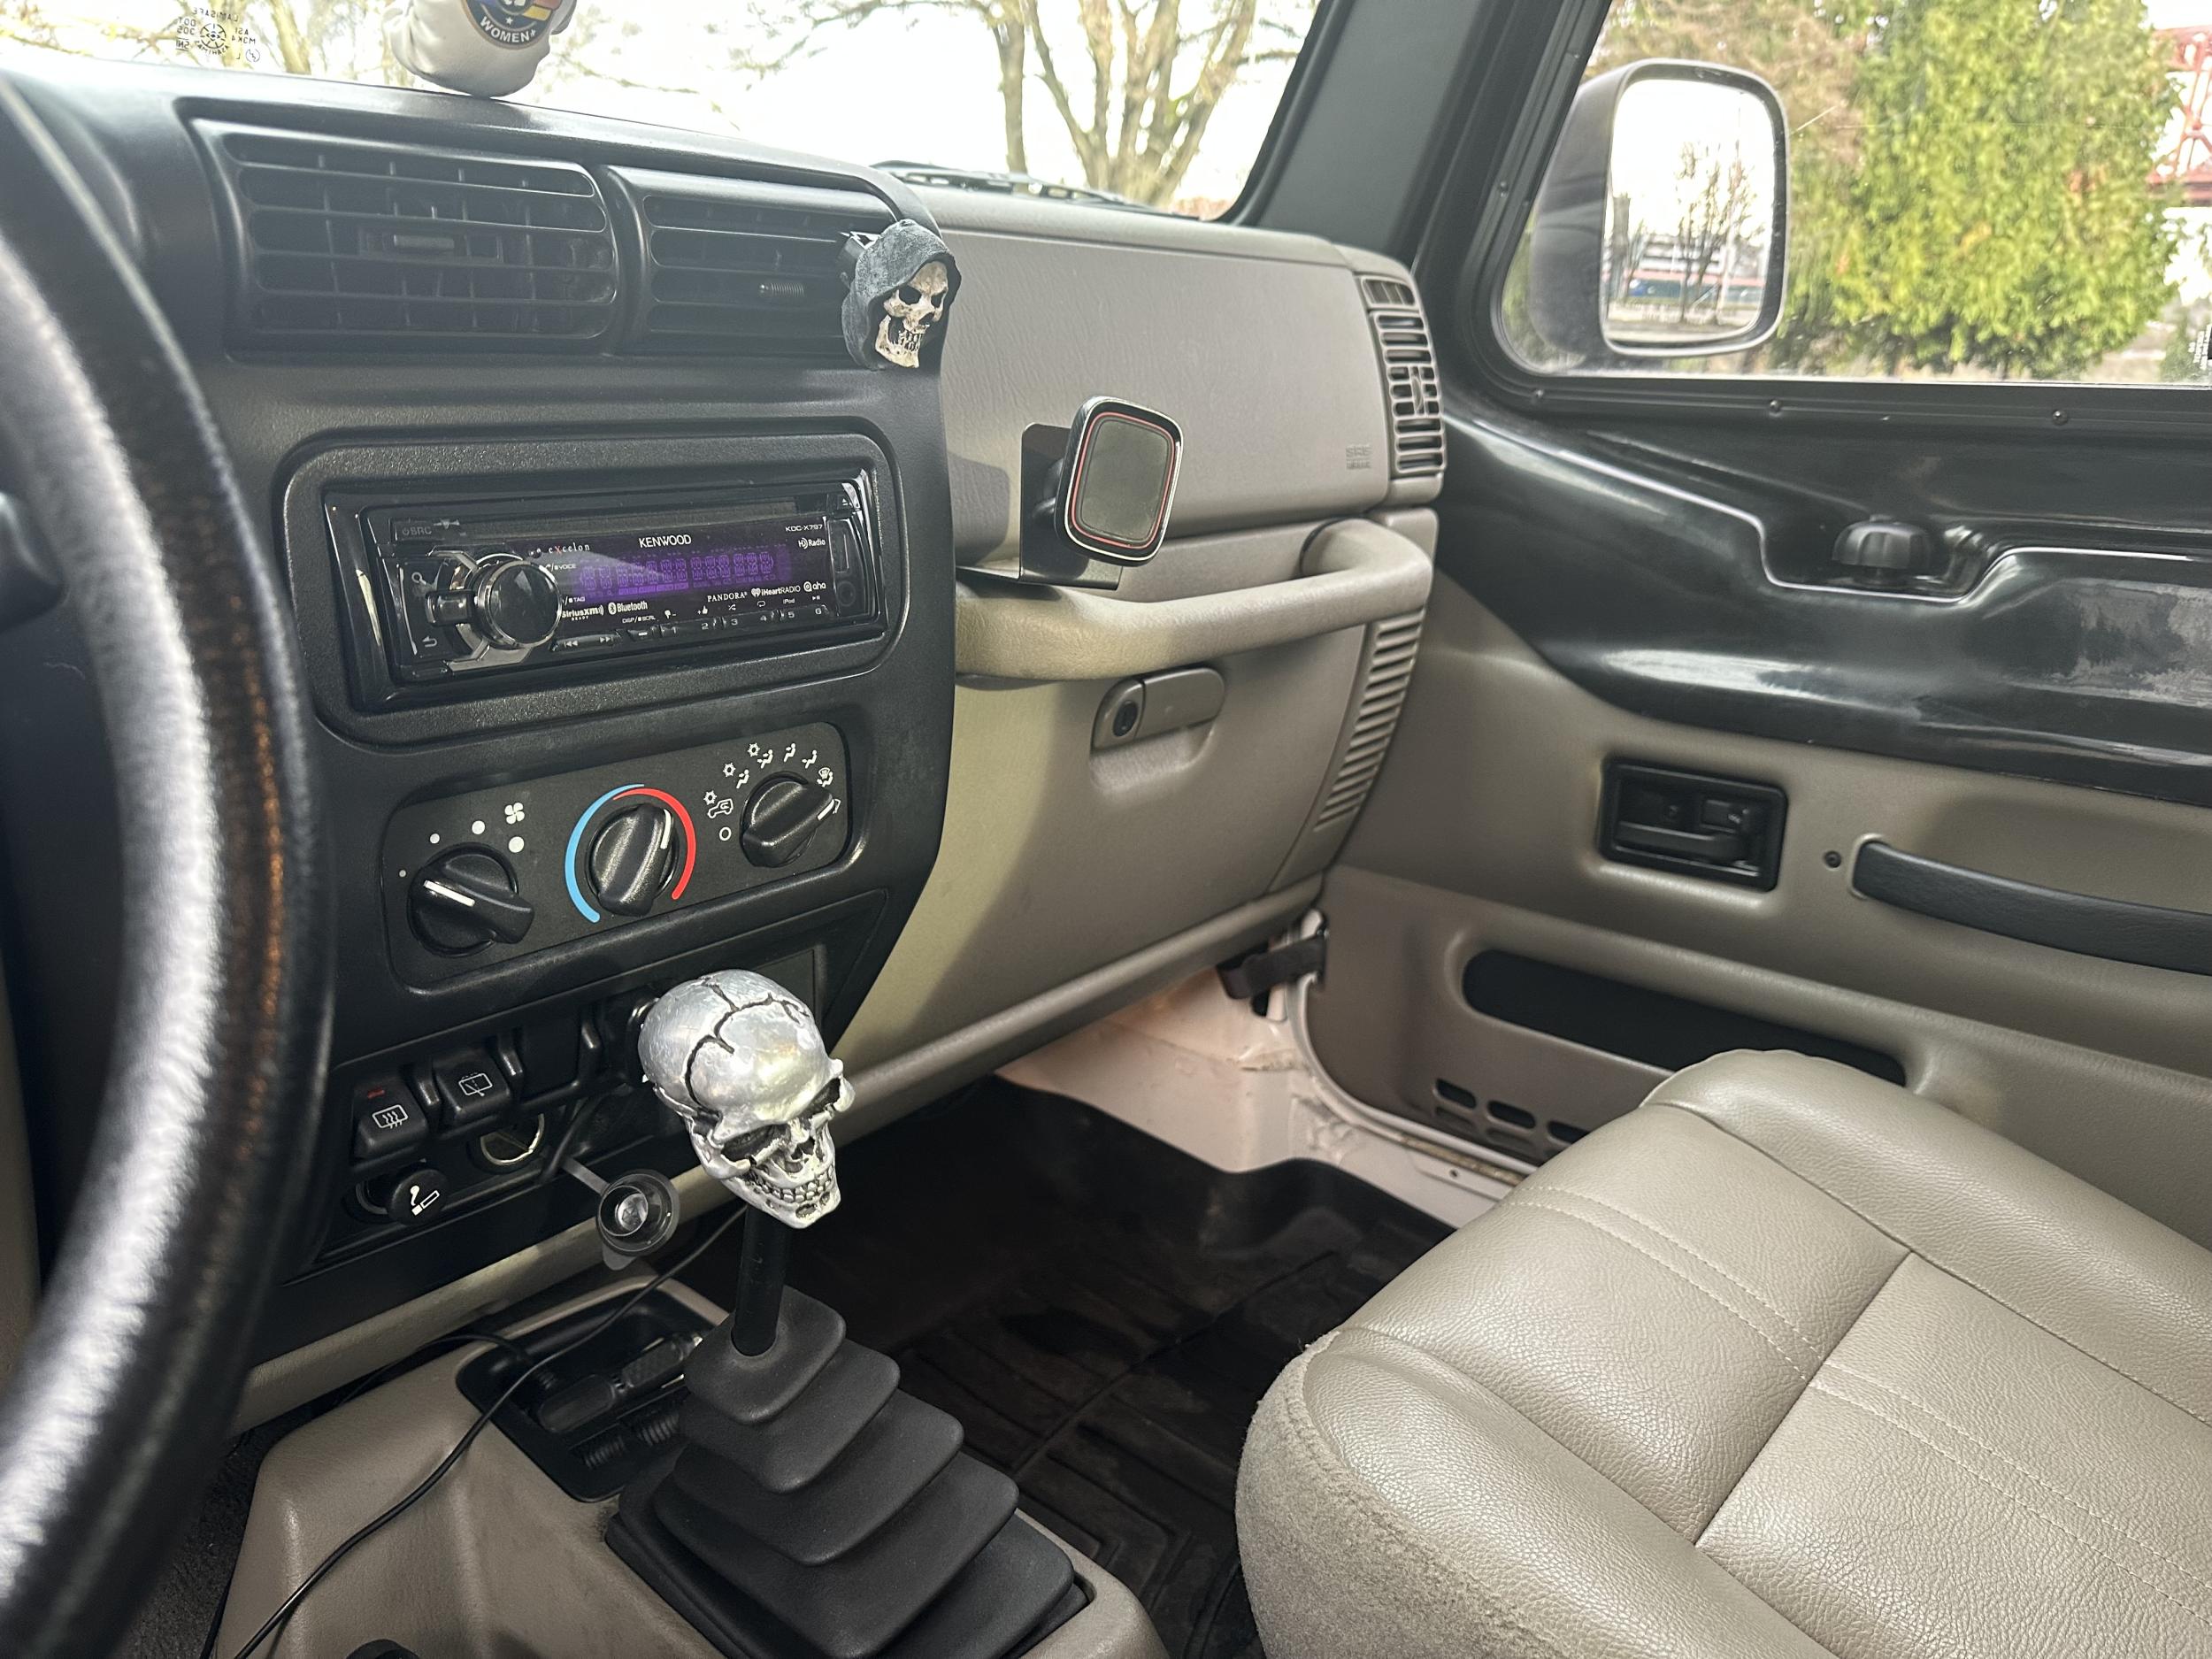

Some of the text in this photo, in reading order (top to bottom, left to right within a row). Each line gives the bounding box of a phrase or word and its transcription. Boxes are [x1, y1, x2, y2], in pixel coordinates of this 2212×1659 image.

[480, 16, 530, 42] WOMEN
[639, 534, 692, 548] KENWOOD
[809, 538, 826, 547] Radio
[707, 590, 745, 602] PANDORA
[617, 601, 648, 612] Bluetooth
